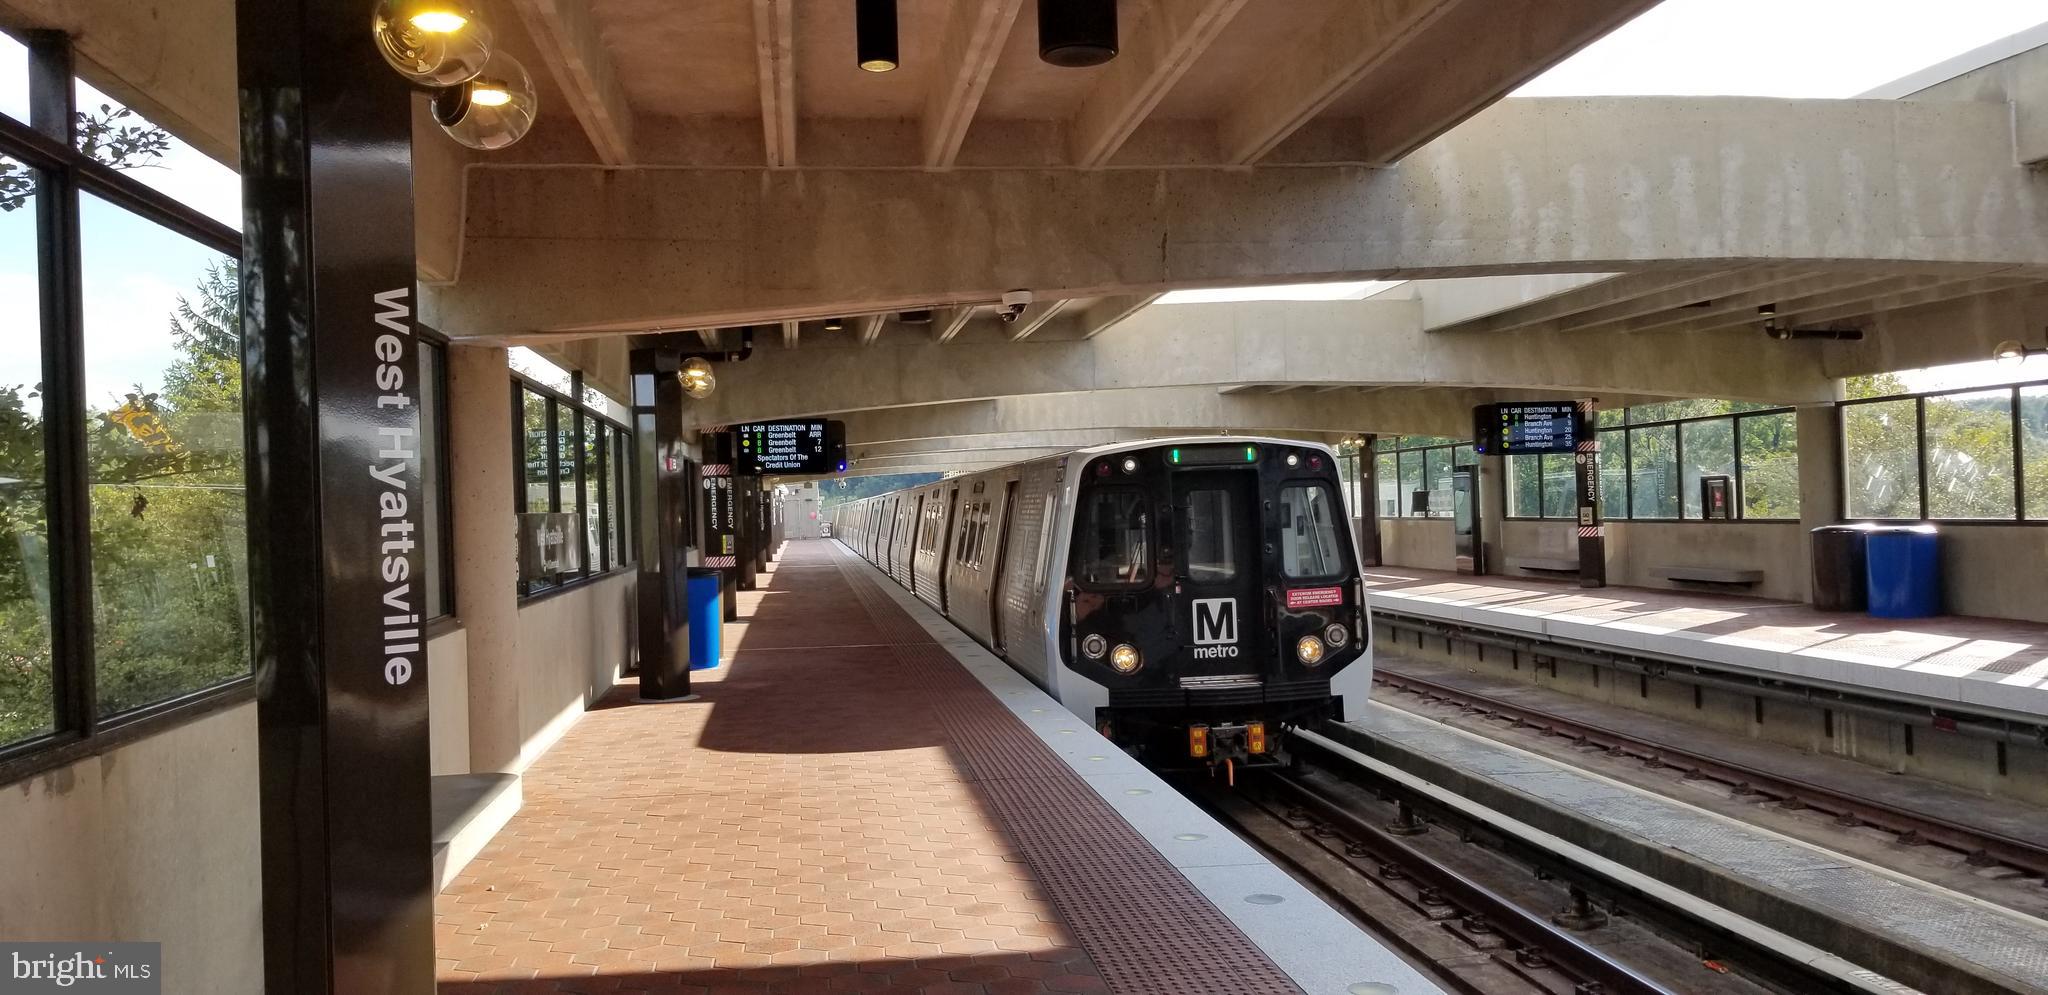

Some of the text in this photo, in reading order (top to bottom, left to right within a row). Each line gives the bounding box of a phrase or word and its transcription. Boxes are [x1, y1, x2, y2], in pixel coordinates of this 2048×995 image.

[369, 287, 420, 685] West Hyattsville
[1586, 453, 1595, 502] EMERGENCY
[710, 477, 718, 530] EMERGENCY
[726, 477, 734, 529] EMERGENCY
[1195, 601, 1235, 641] M
[1194, 645, 1239, 659] metro
